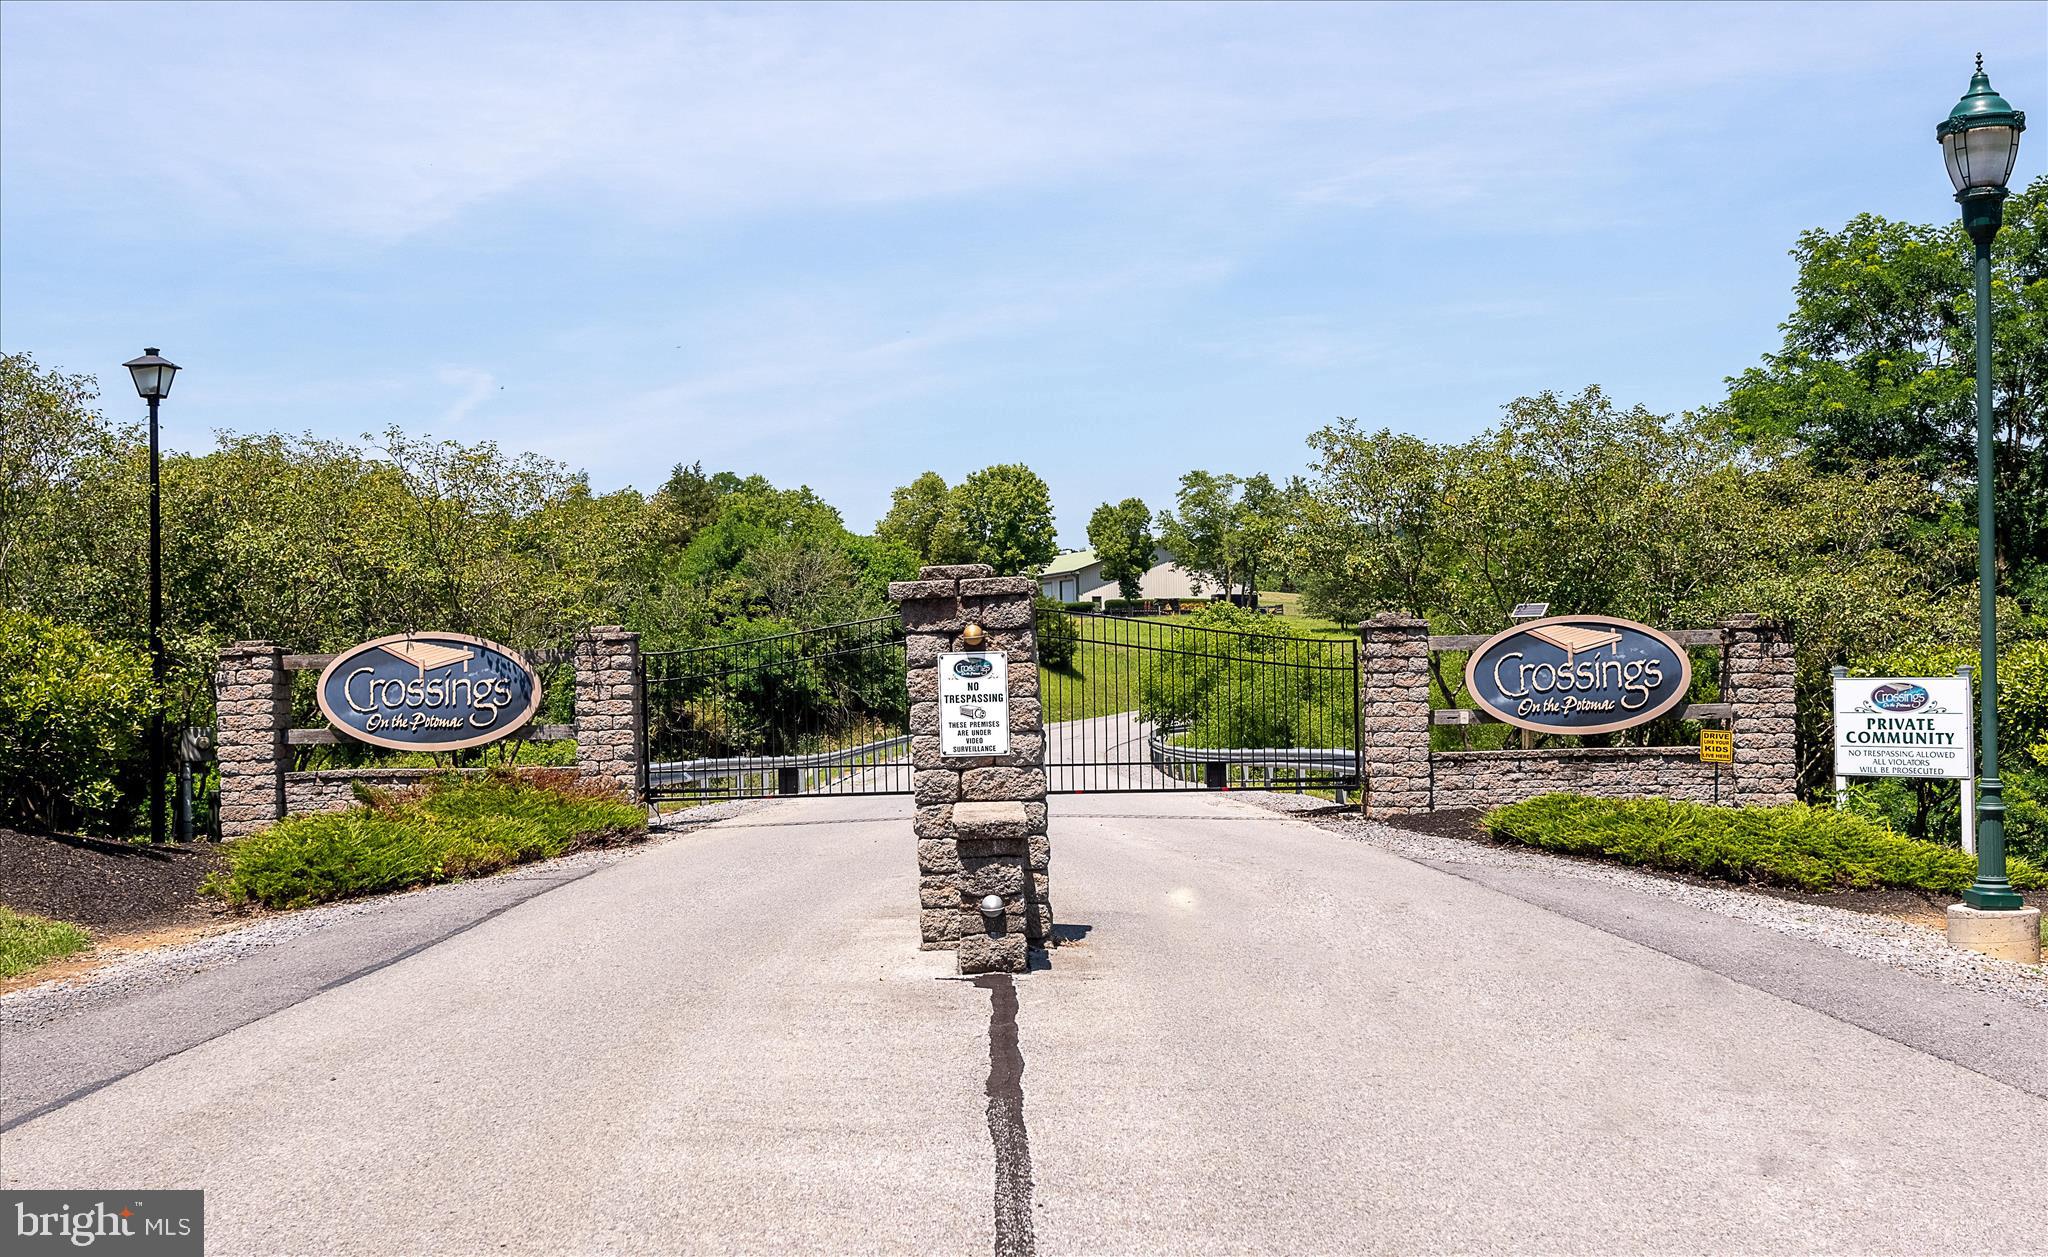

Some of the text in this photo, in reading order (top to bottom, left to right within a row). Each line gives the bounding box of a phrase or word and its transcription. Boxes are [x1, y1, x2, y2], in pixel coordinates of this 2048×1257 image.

[967, 682, 979, 691] NO
[1494, 652, 1663, 709] Crossings
[344, 667, 512, 727] Crossings
[944, 693, 1004, 704] TRESPASSING
[1874, 689, 1925, 708] Crossings
[1518, 695, 1615, 716] On the Potomac
[366, 712, 464, 732] On the Potomac
[1867, 718, 1936, 731] PRIVATE
[1846, 731, 1955, 745] COMMUNITY
[953, 745, 997, 753] SURVEILLANCE
[1848, 749, 1956, 759] NO TRESPASSING ALLOWED
[1873, 758, 1886, 766] ALL
[1892, 767, 1944, 775] PROSECUTED
